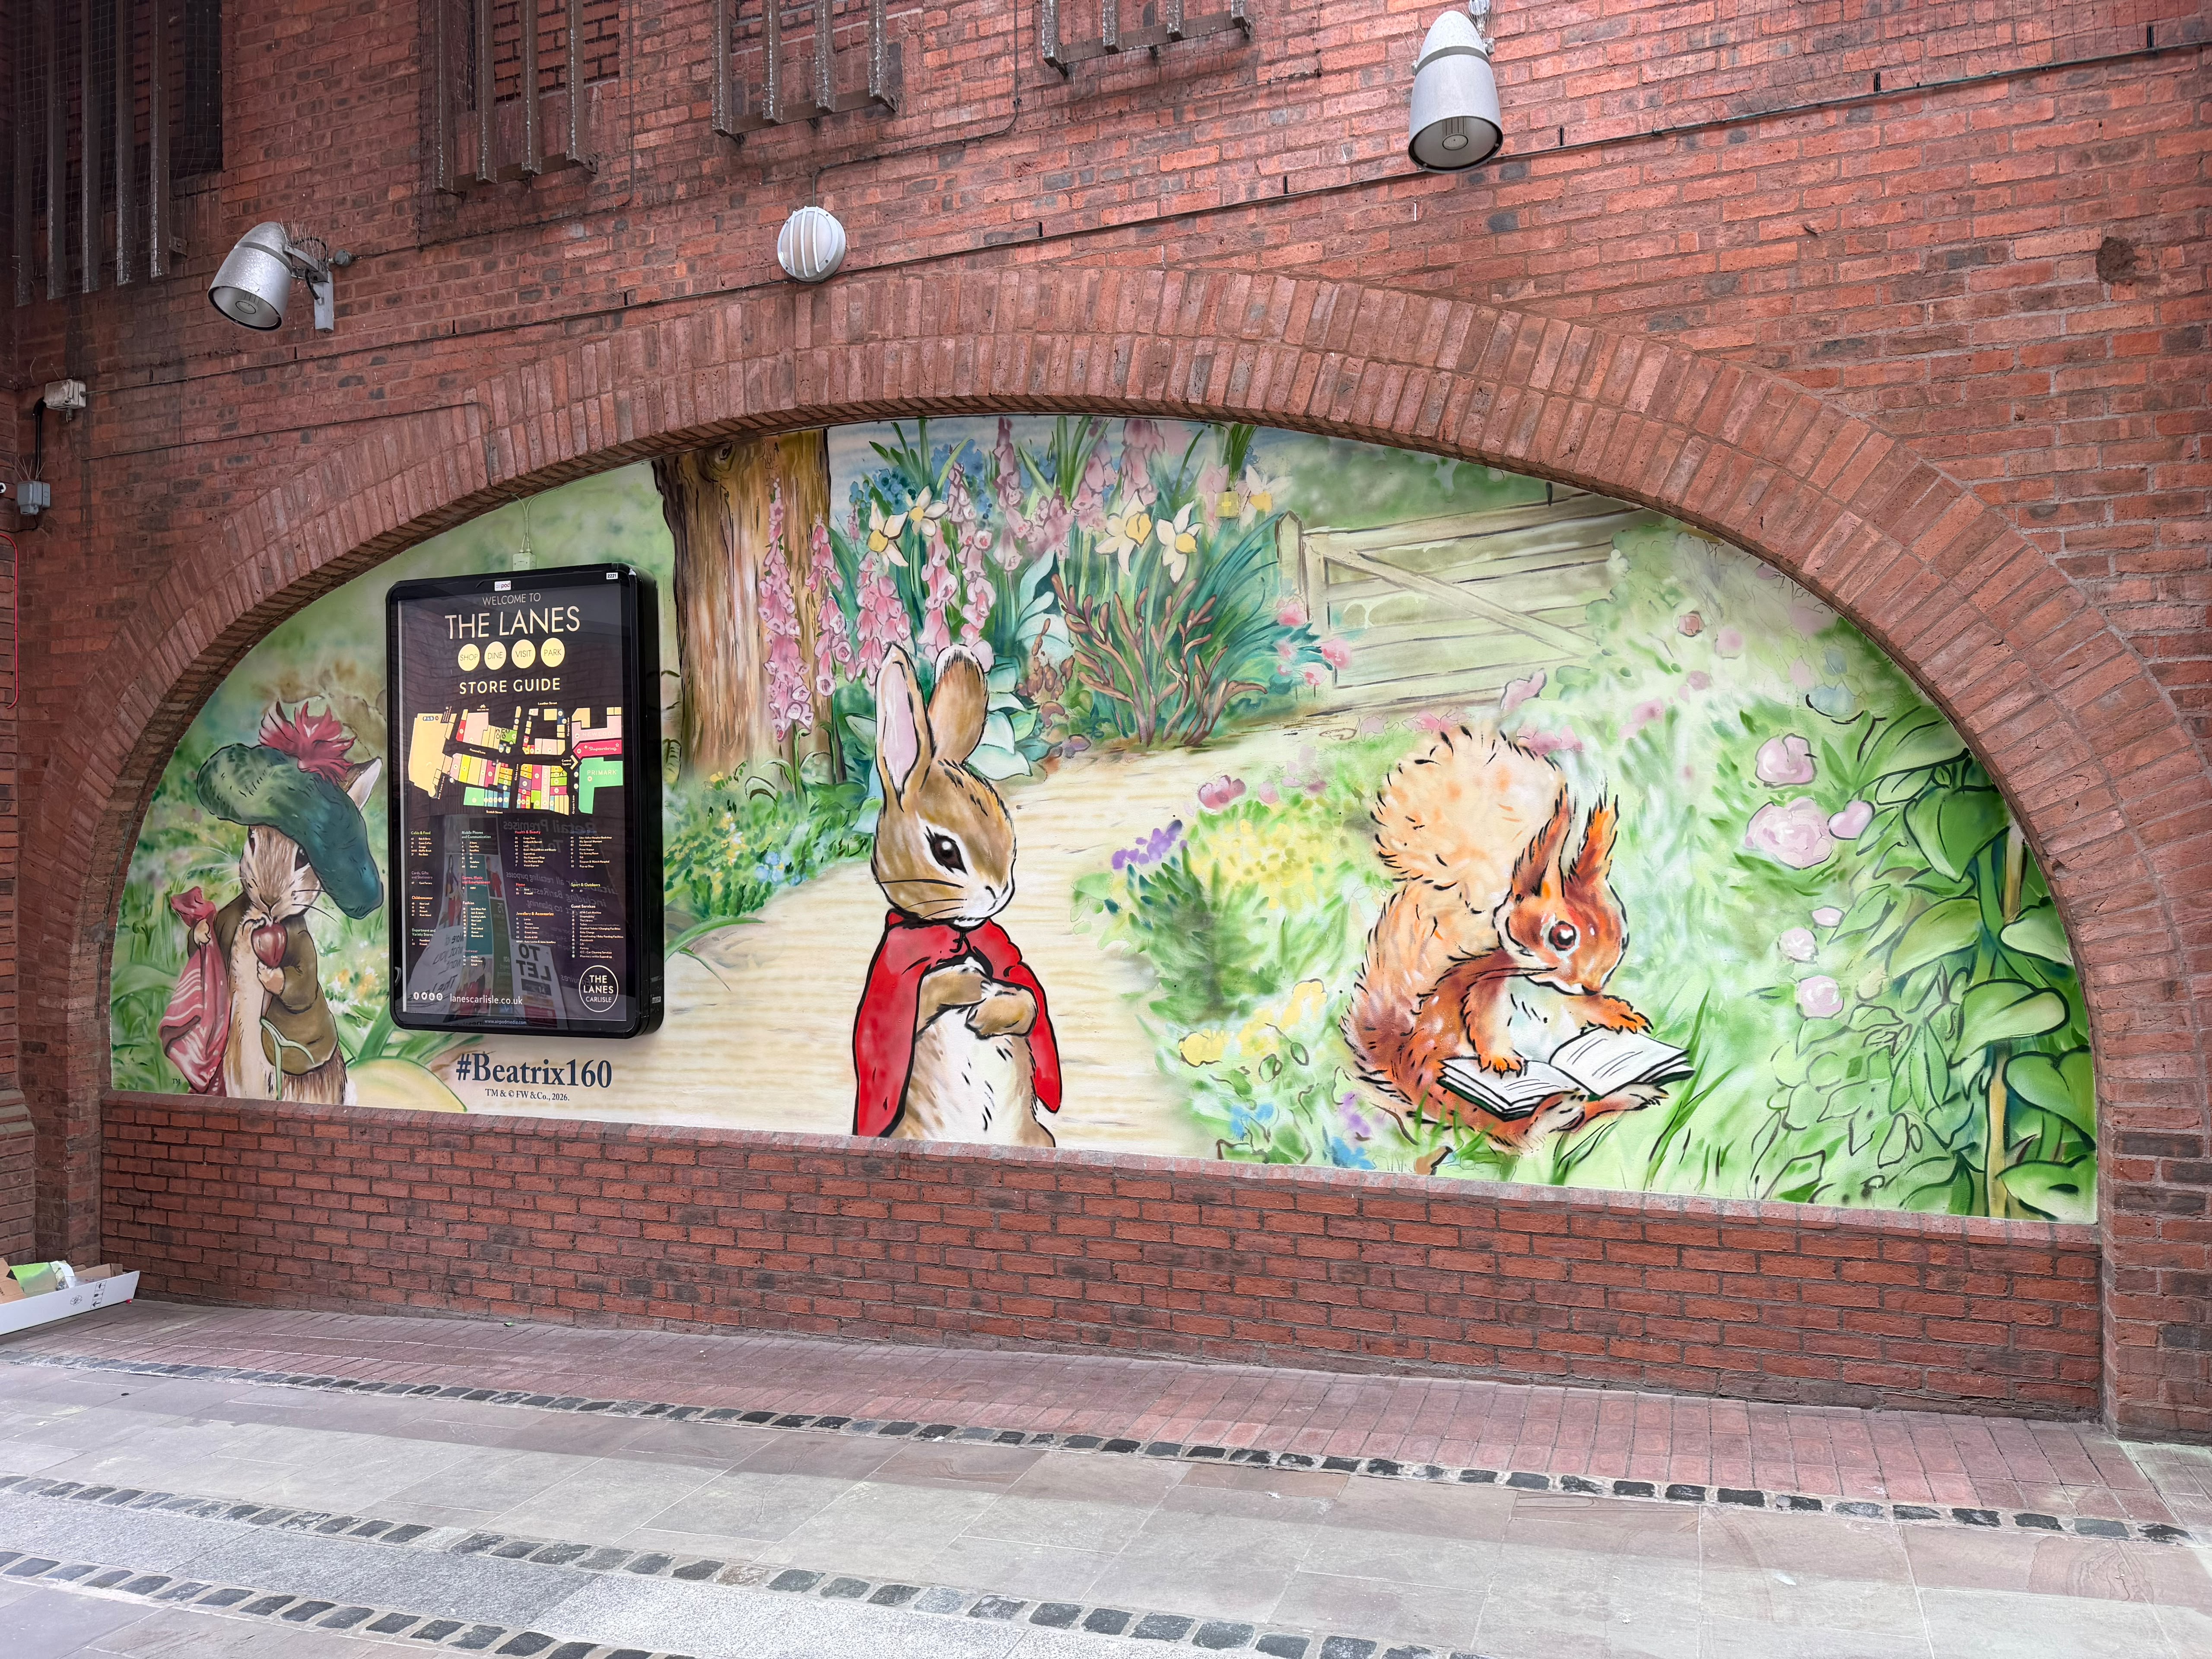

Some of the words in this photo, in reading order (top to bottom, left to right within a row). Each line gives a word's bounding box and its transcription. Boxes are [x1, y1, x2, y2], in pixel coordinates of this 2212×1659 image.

[483, 594, 526, 605] WELCOME
[529, 593, 541, 601] TO
[445, 613, 490, 639] THE
[499, 606, 580, 636] LANES
[460, 652, 478, 661] SHOP
[459, 680, 507, 695] STORE
[513, 678, 560, 692] GUIDE
[589, 975, 607, 983] THE
[584, 985, 614, 994] LANES
[450, 993, 522, 1005] lanescarlisle.co.uk
[456, 1053, 612, 1088] #Beatrix160
[516, 1090, 528, 1099] FW
[552, 1093, 570, 1101] 2026.
